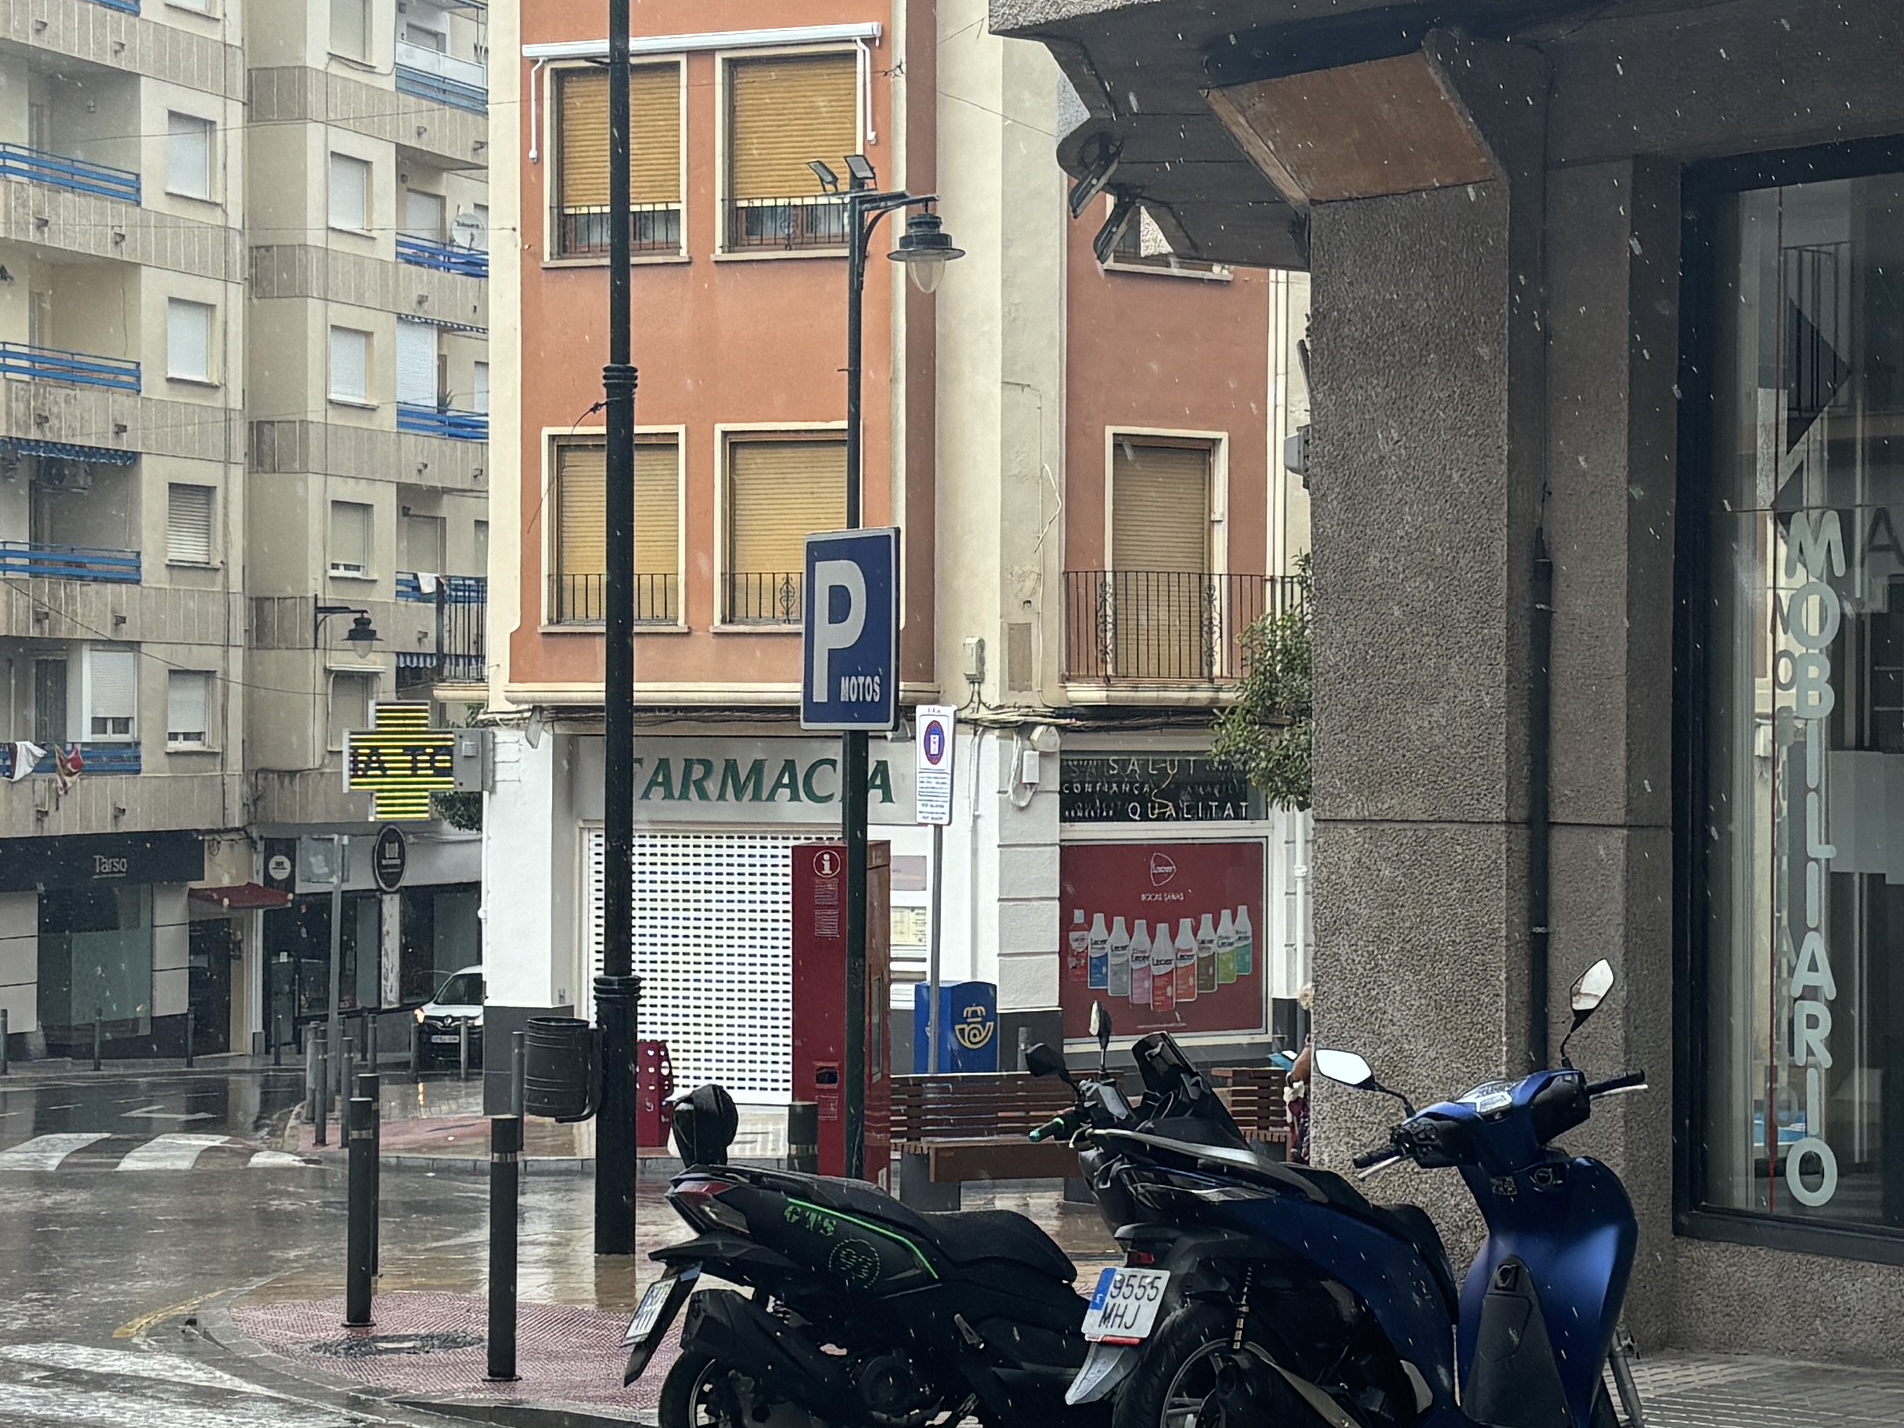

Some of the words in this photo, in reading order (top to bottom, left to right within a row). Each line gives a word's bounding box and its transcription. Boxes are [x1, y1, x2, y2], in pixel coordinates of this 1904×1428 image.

[812, 559, 867, 702] P
[840, 675, 881, 702] MOTOS
[1109, 756, 1197, 775] SALUT
[633, 758, 895, 803] ARMACA
[1128, 801, 1249, 821] QUALITAT
[92, 854, 128, 873] Tarso
[1785, 509, 1846, 1207] MOBILIARIO
[1109, 1273, 1162, 1302] 9555
[1098, 1301, 1141, 1330] MHJ
